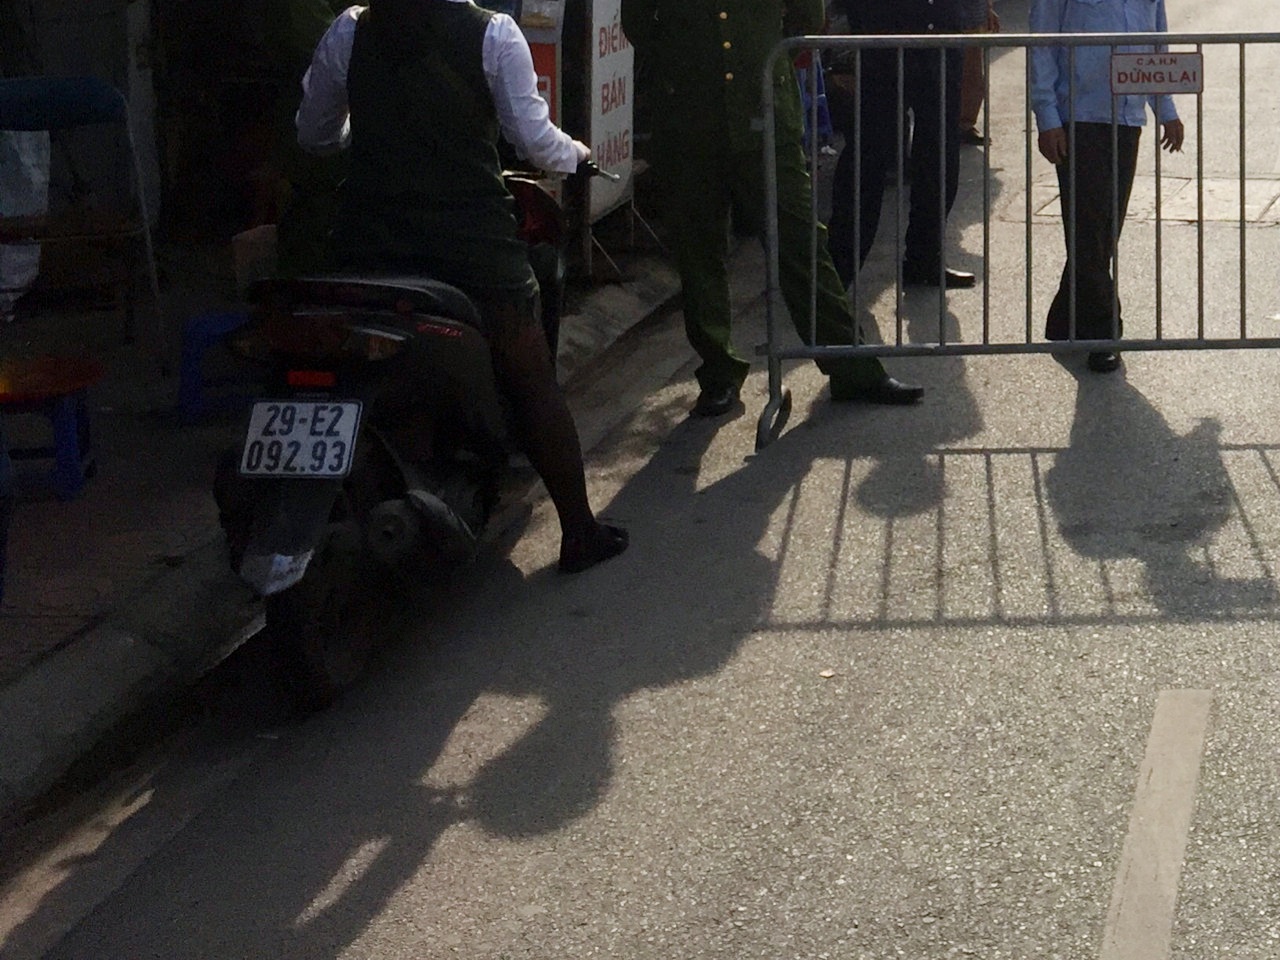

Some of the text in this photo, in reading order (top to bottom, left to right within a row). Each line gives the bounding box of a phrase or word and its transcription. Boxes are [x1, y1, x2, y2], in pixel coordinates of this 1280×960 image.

[601, 72, 627, 115] BÁN
[262, 405, 344, 436] 29-E2
[246, 440, 347, 473] 092.93
